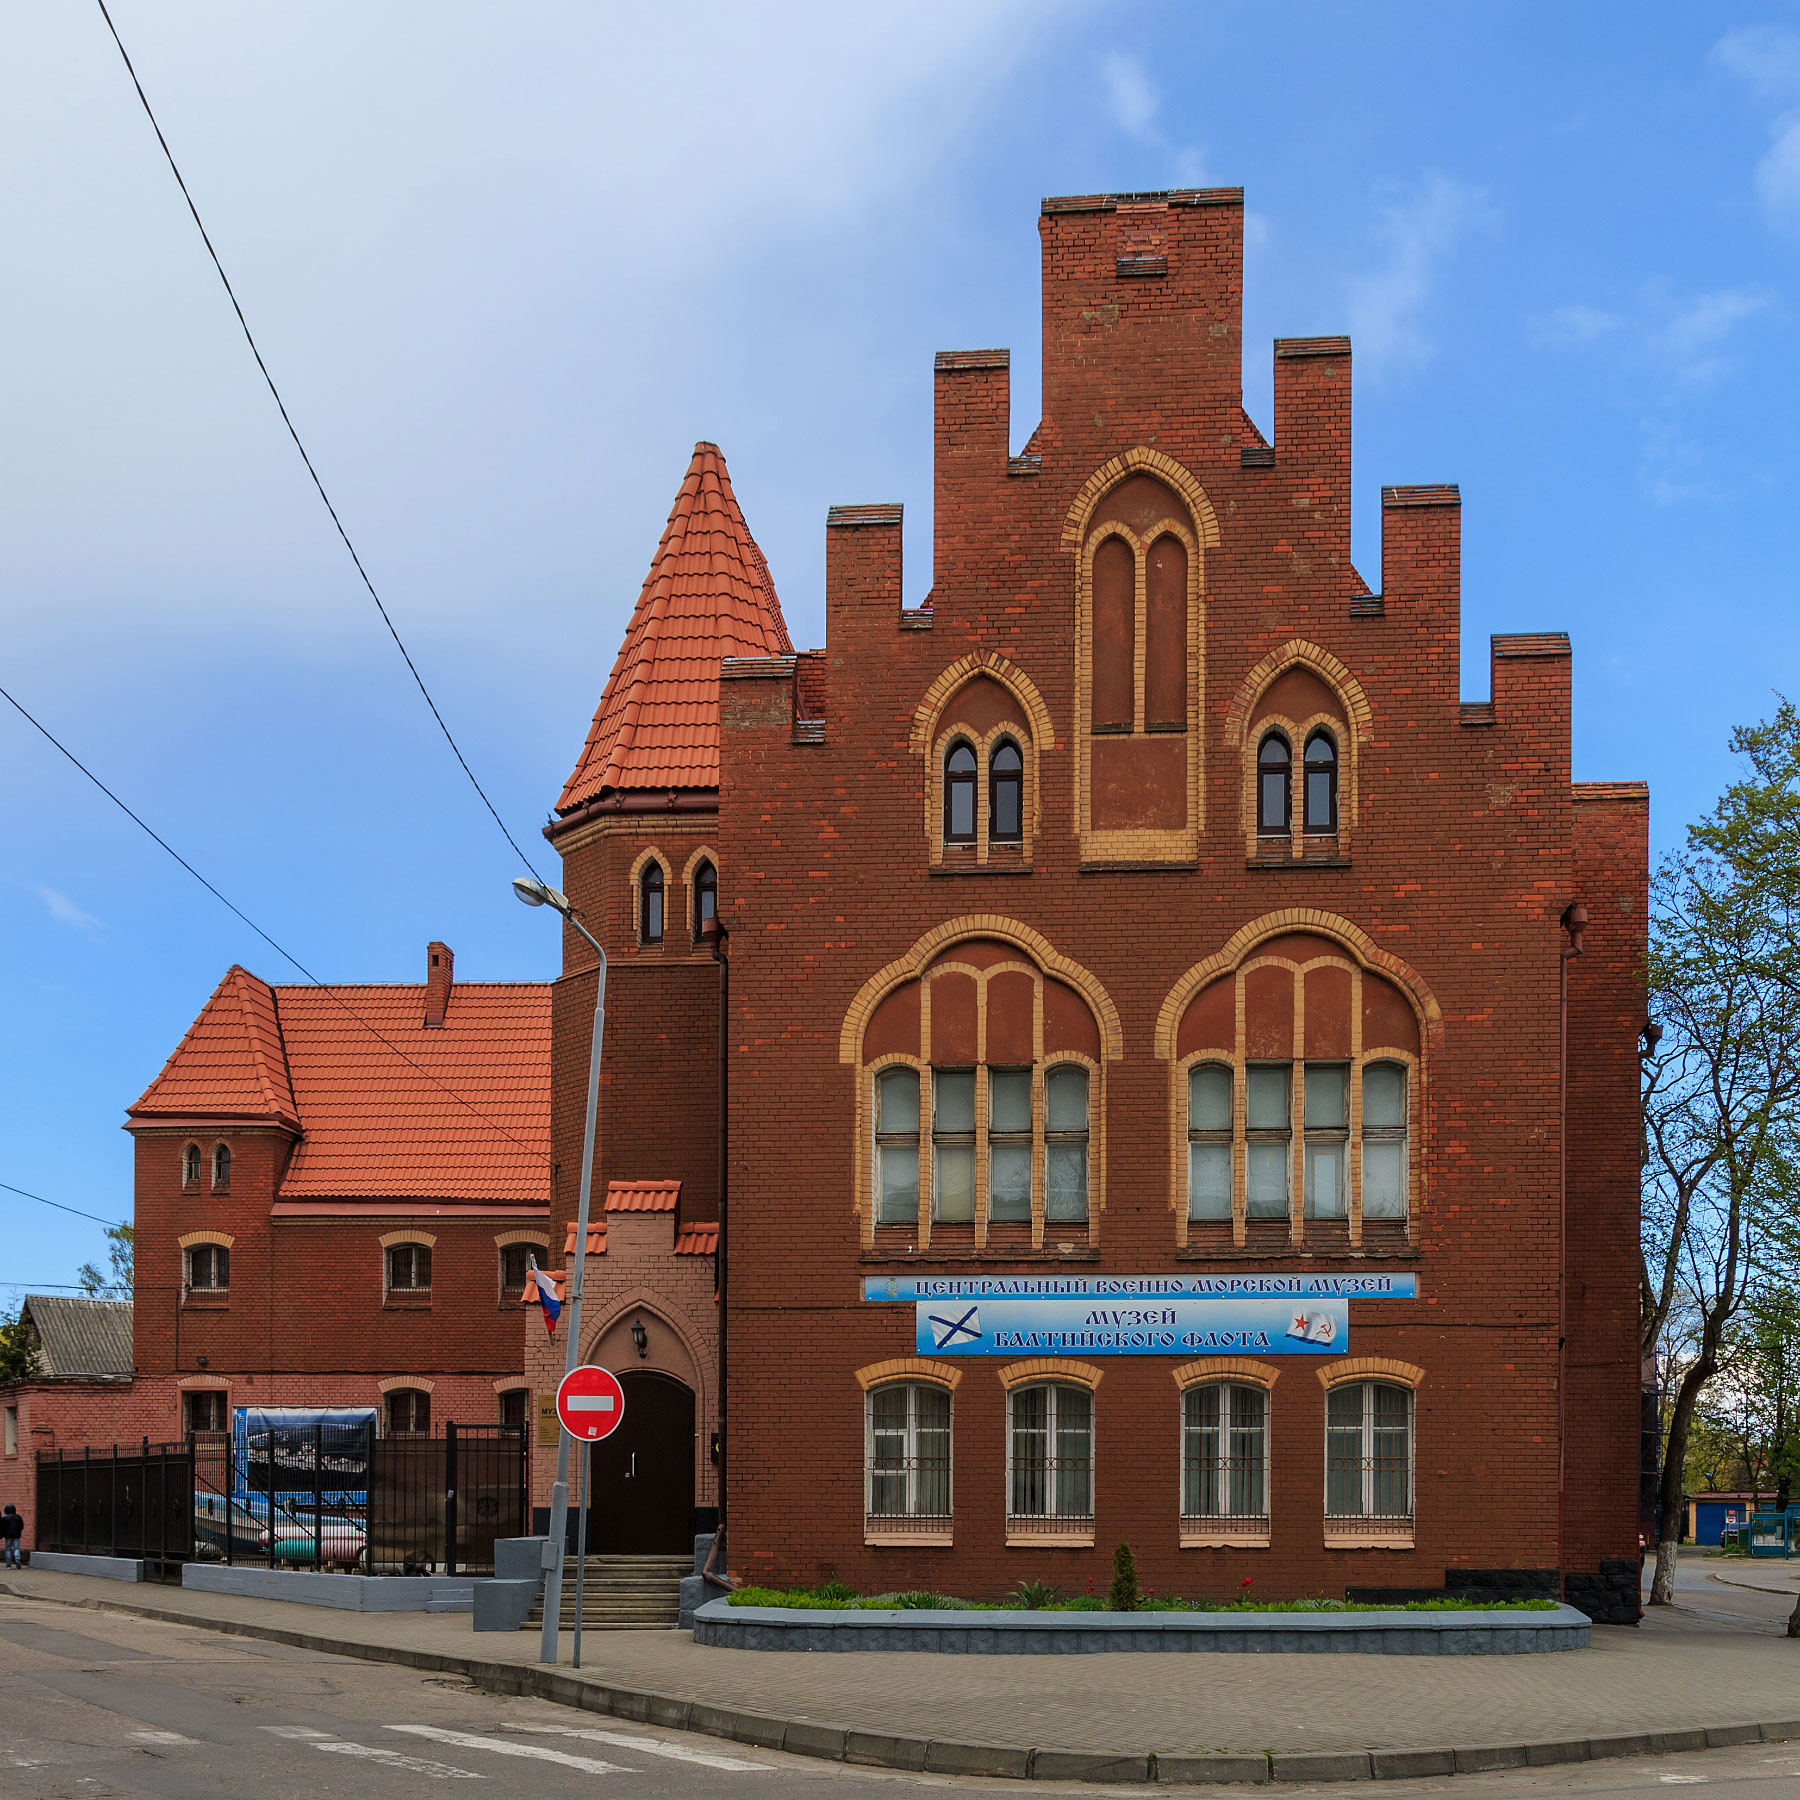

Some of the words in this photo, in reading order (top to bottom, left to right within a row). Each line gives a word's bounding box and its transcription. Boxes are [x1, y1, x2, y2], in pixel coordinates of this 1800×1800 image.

[914, 1278, 1089, 1297] ЦЕНТРАЛЬНЫЙ
[1309, 1275, 1393, 1296] МУЗЕЙ
[1085, 1307, 1178, 1328] МУЗЕЙ
[993, 1330, 1175, 1347] БАЛТИЙСКОГО
[1181, 1331, 1271, 1347] ФЛОТА
